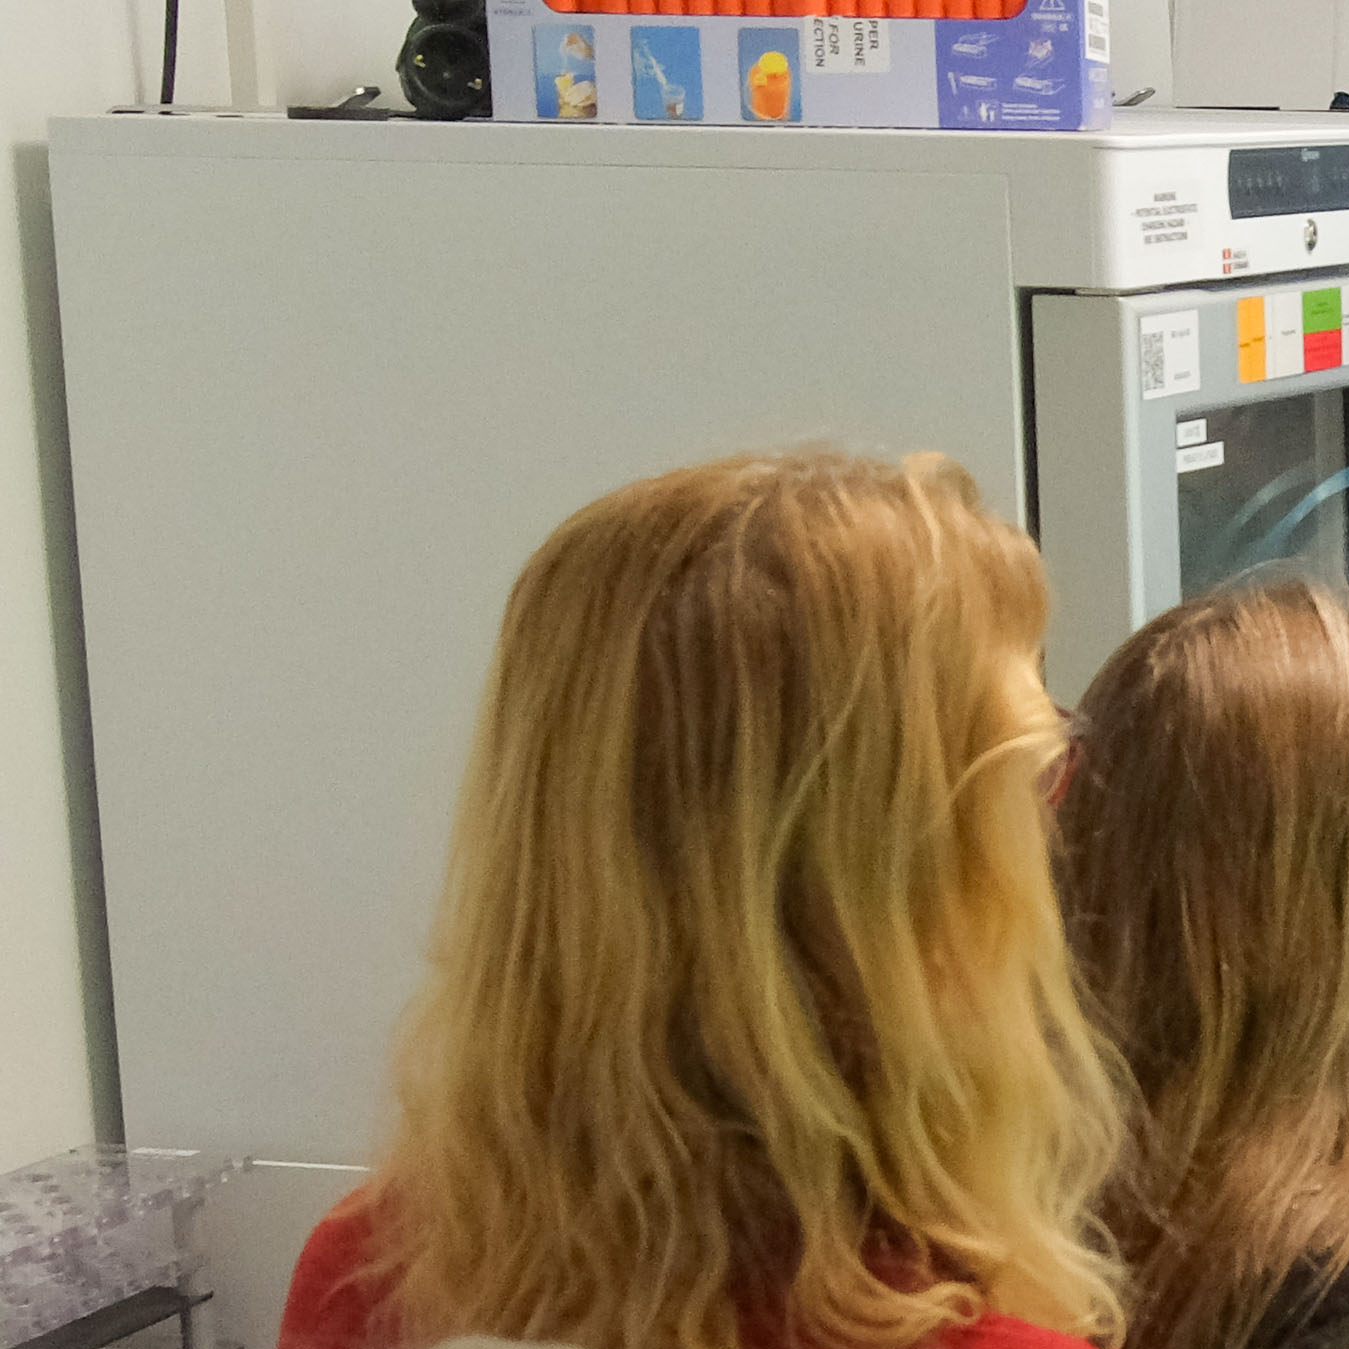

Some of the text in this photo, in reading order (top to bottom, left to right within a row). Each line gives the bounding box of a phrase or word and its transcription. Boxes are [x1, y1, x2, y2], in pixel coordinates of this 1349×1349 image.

[814, 19, 826, 67] ECTION
[829, 24, 840, 55] FOR
[853, 22, 865, 66] URINE
